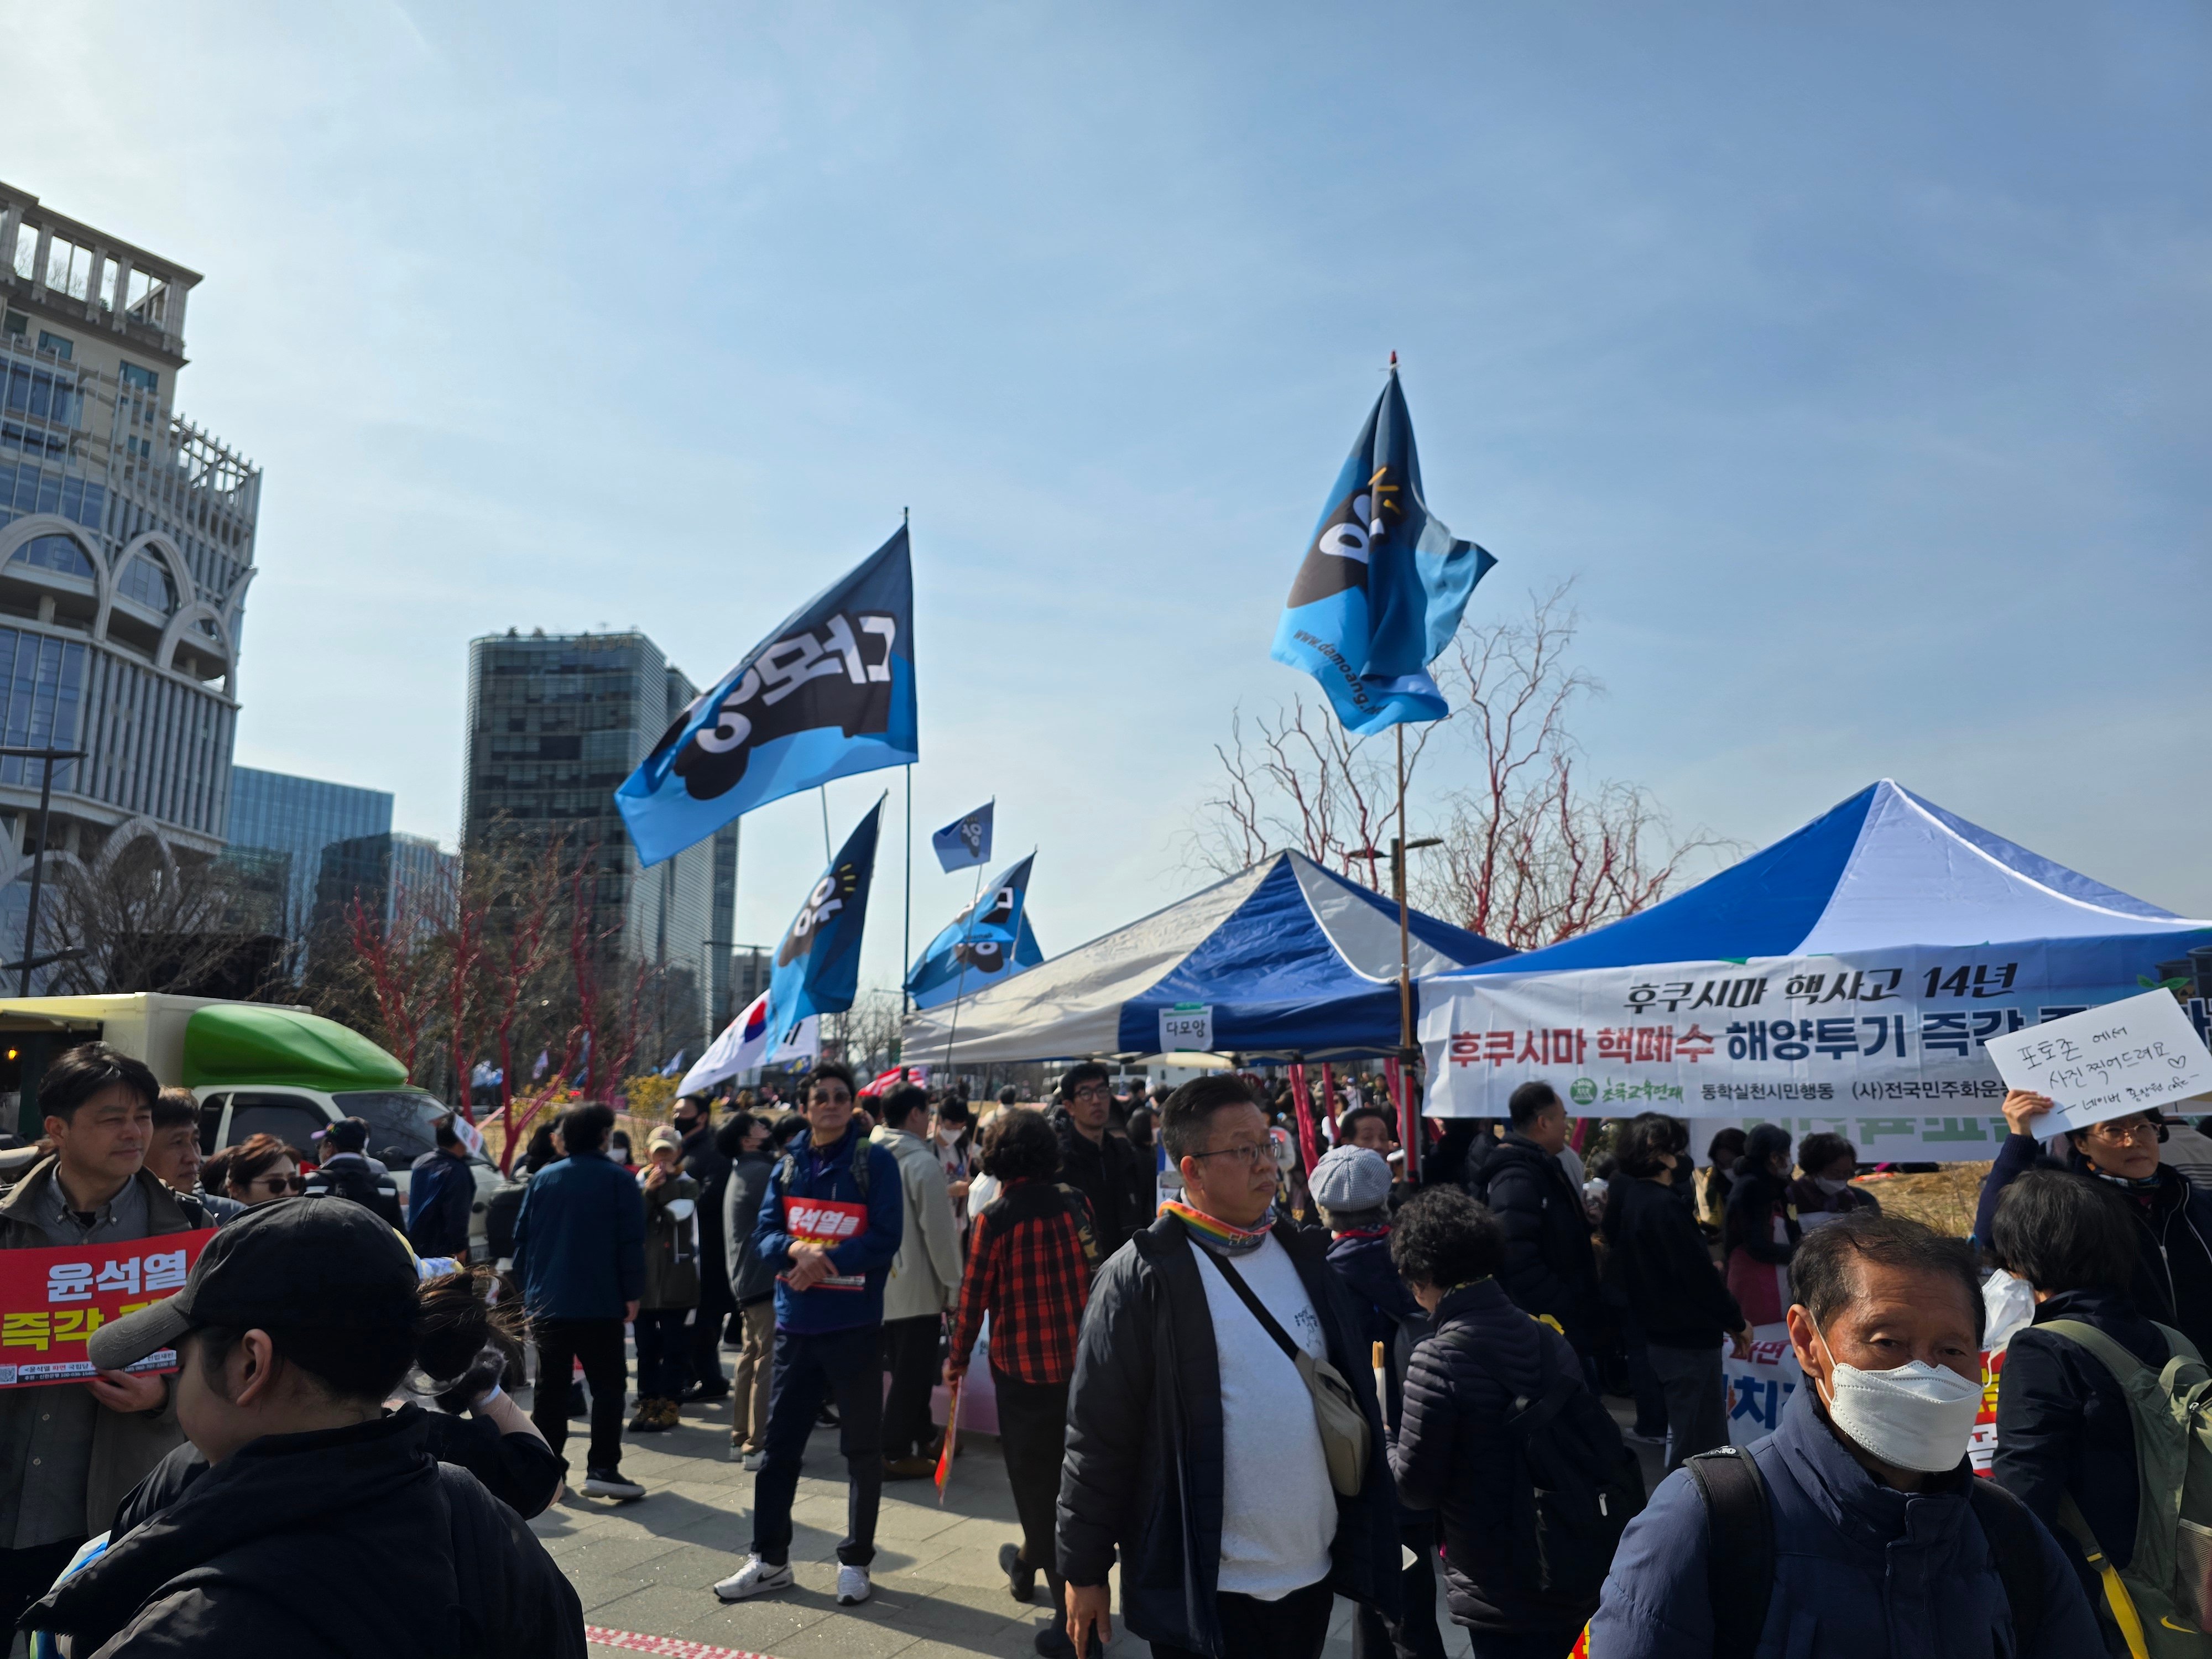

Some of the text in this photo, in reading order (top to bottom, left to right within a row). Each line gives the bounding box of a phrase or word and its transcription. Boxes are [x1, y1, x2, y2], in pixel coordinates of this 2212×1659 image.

[1624, 962, 2018, 1014] 후쿠시마 핵사고 14년
[1166, 1019, 1206, 1038] 다모앙
[1450, 1010, 2025, 1068] 후쿠시마 핵폐수 해양투기 즉각
[2017, 1026, 2128, 1070] 포토존 에서
[2049, 1041, 2170, 1090] 사진 찍어드려요
[1700, 1080, 2010, 1100] 동학실천시민행동 (사)전국민주화운
[2082, 1093, 2121, 1110] 네이버
[48, 1249, 187, 1302] 윤석열
[2, 1307, 105, 1351] 즉각
